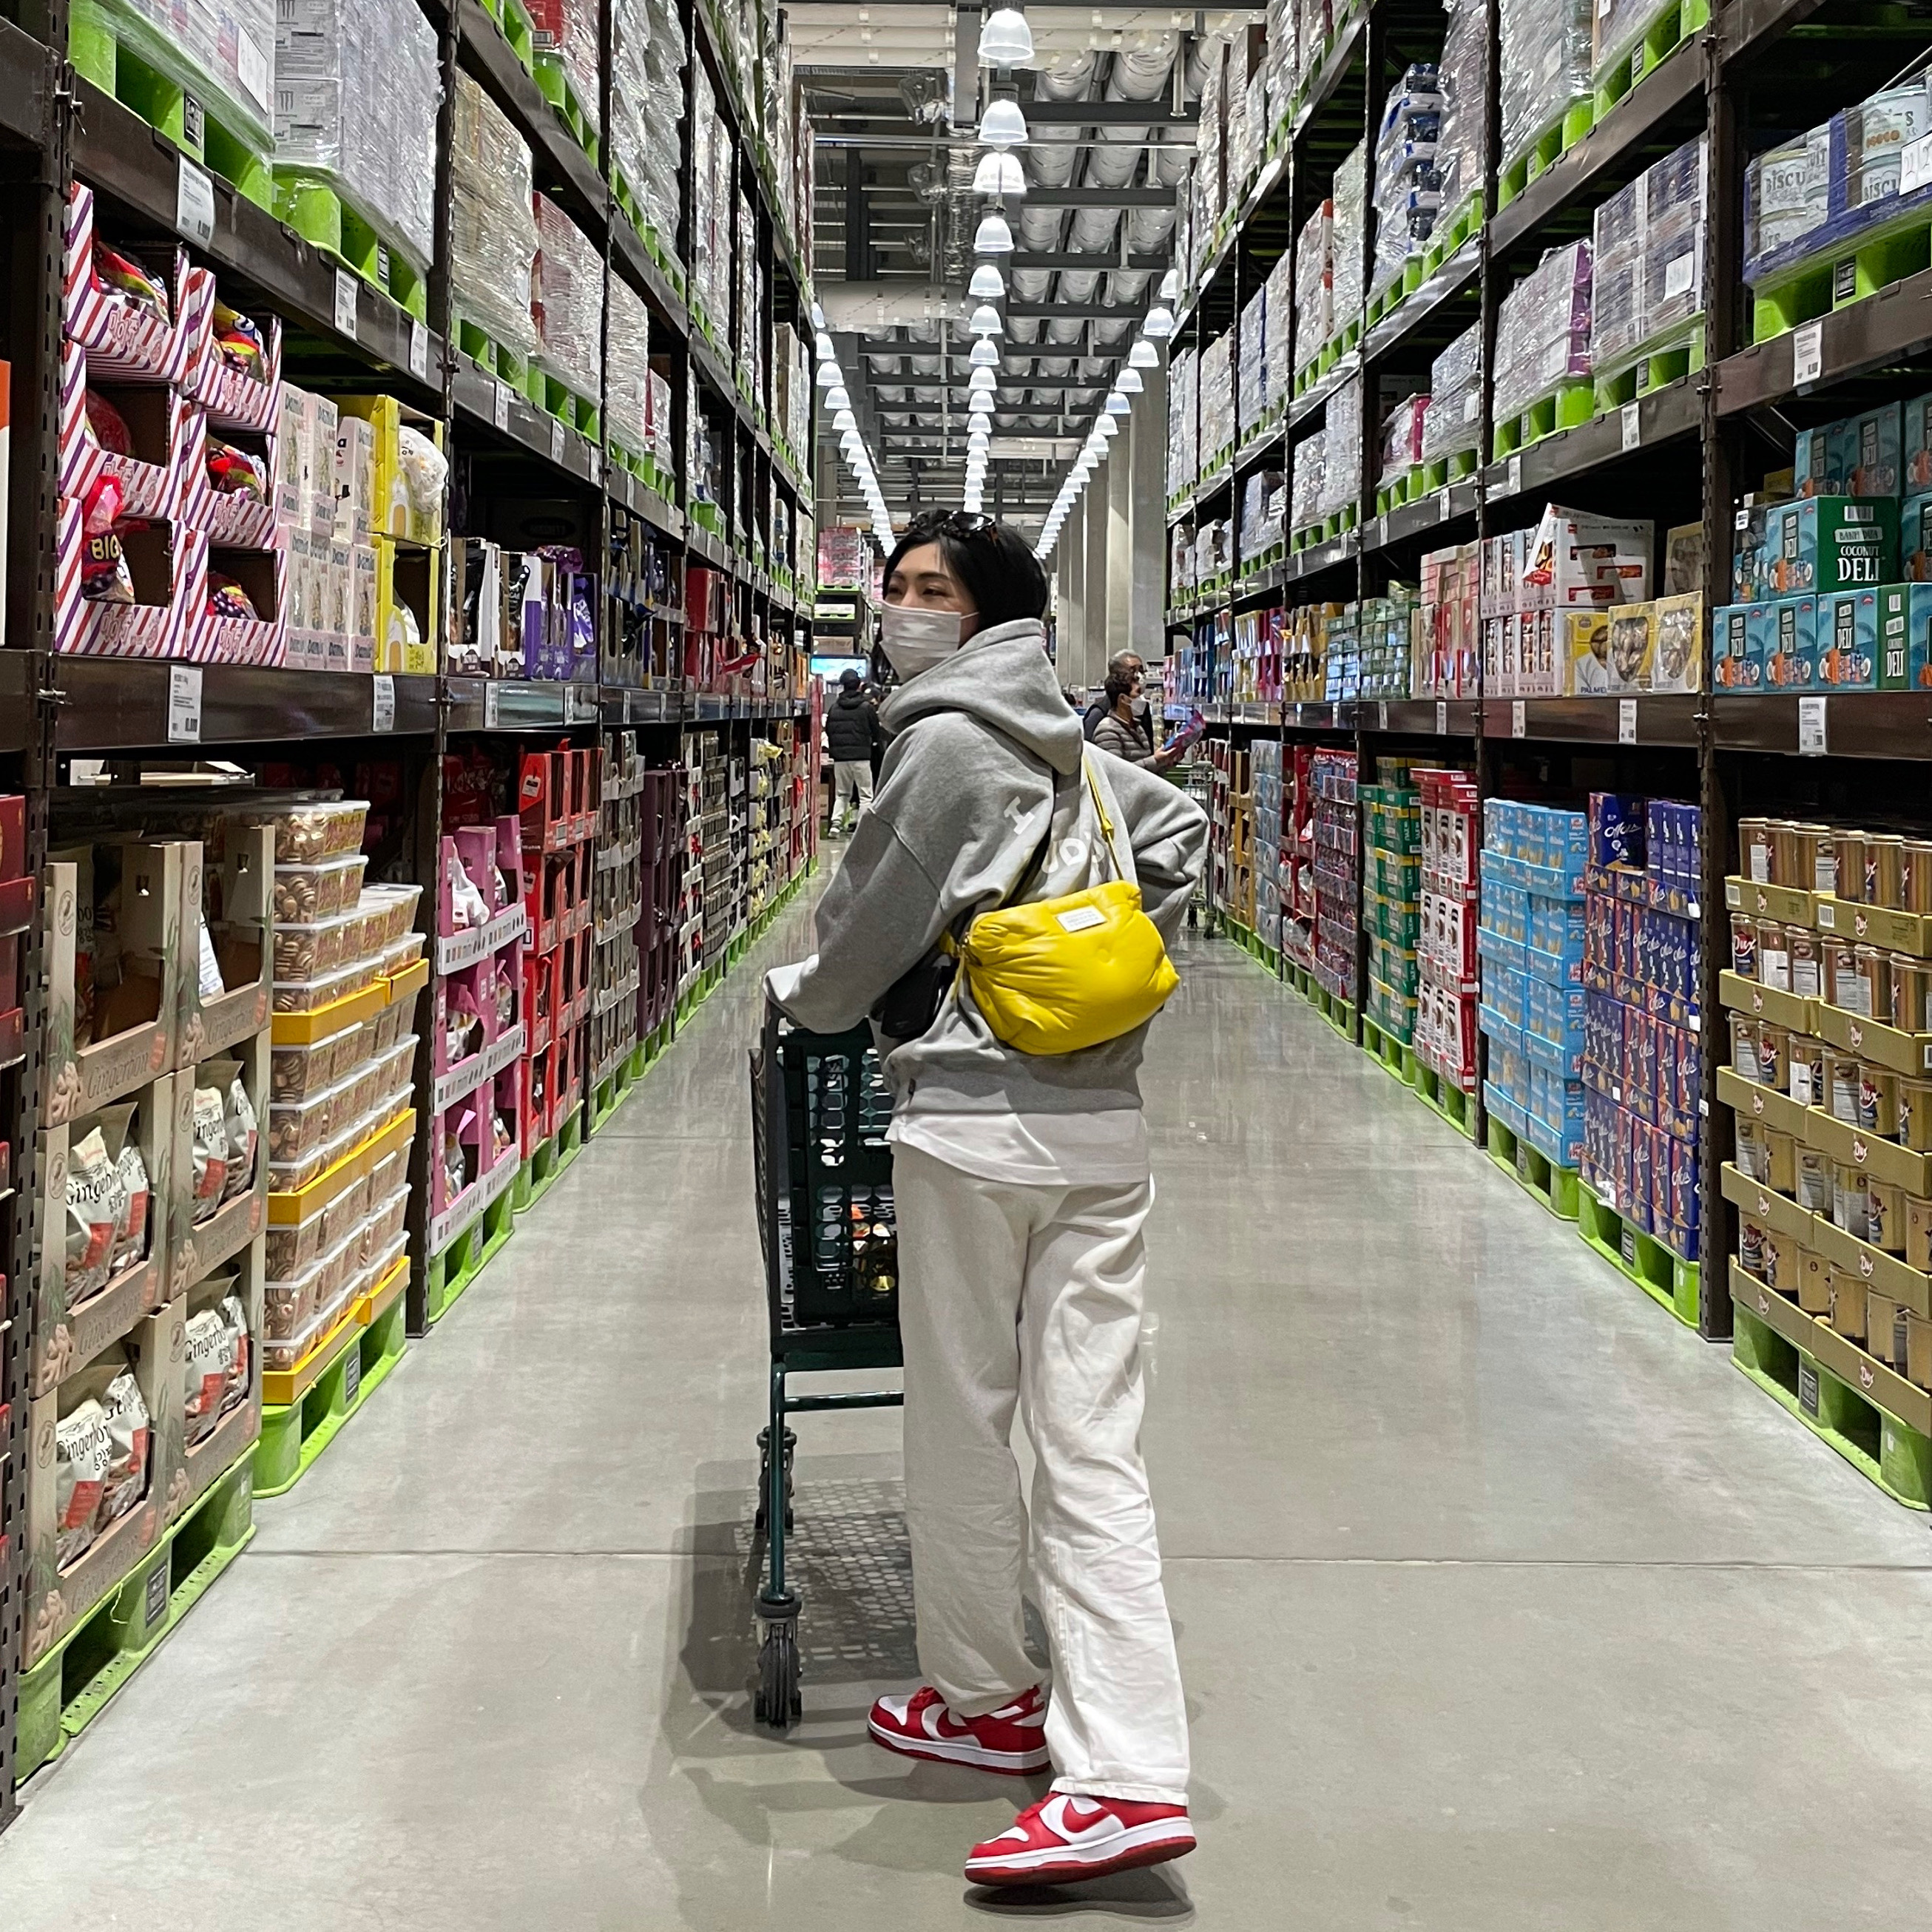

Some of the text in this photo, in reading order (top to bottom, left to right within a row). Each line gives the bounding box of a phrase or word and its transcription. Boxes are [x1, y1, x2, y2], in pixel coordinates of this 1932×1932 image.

[1840, 545, 1880, 556] COCONUT
[1837, 557, 1880, 581] DELI
[1733, 935, 1757, 953] Dux
